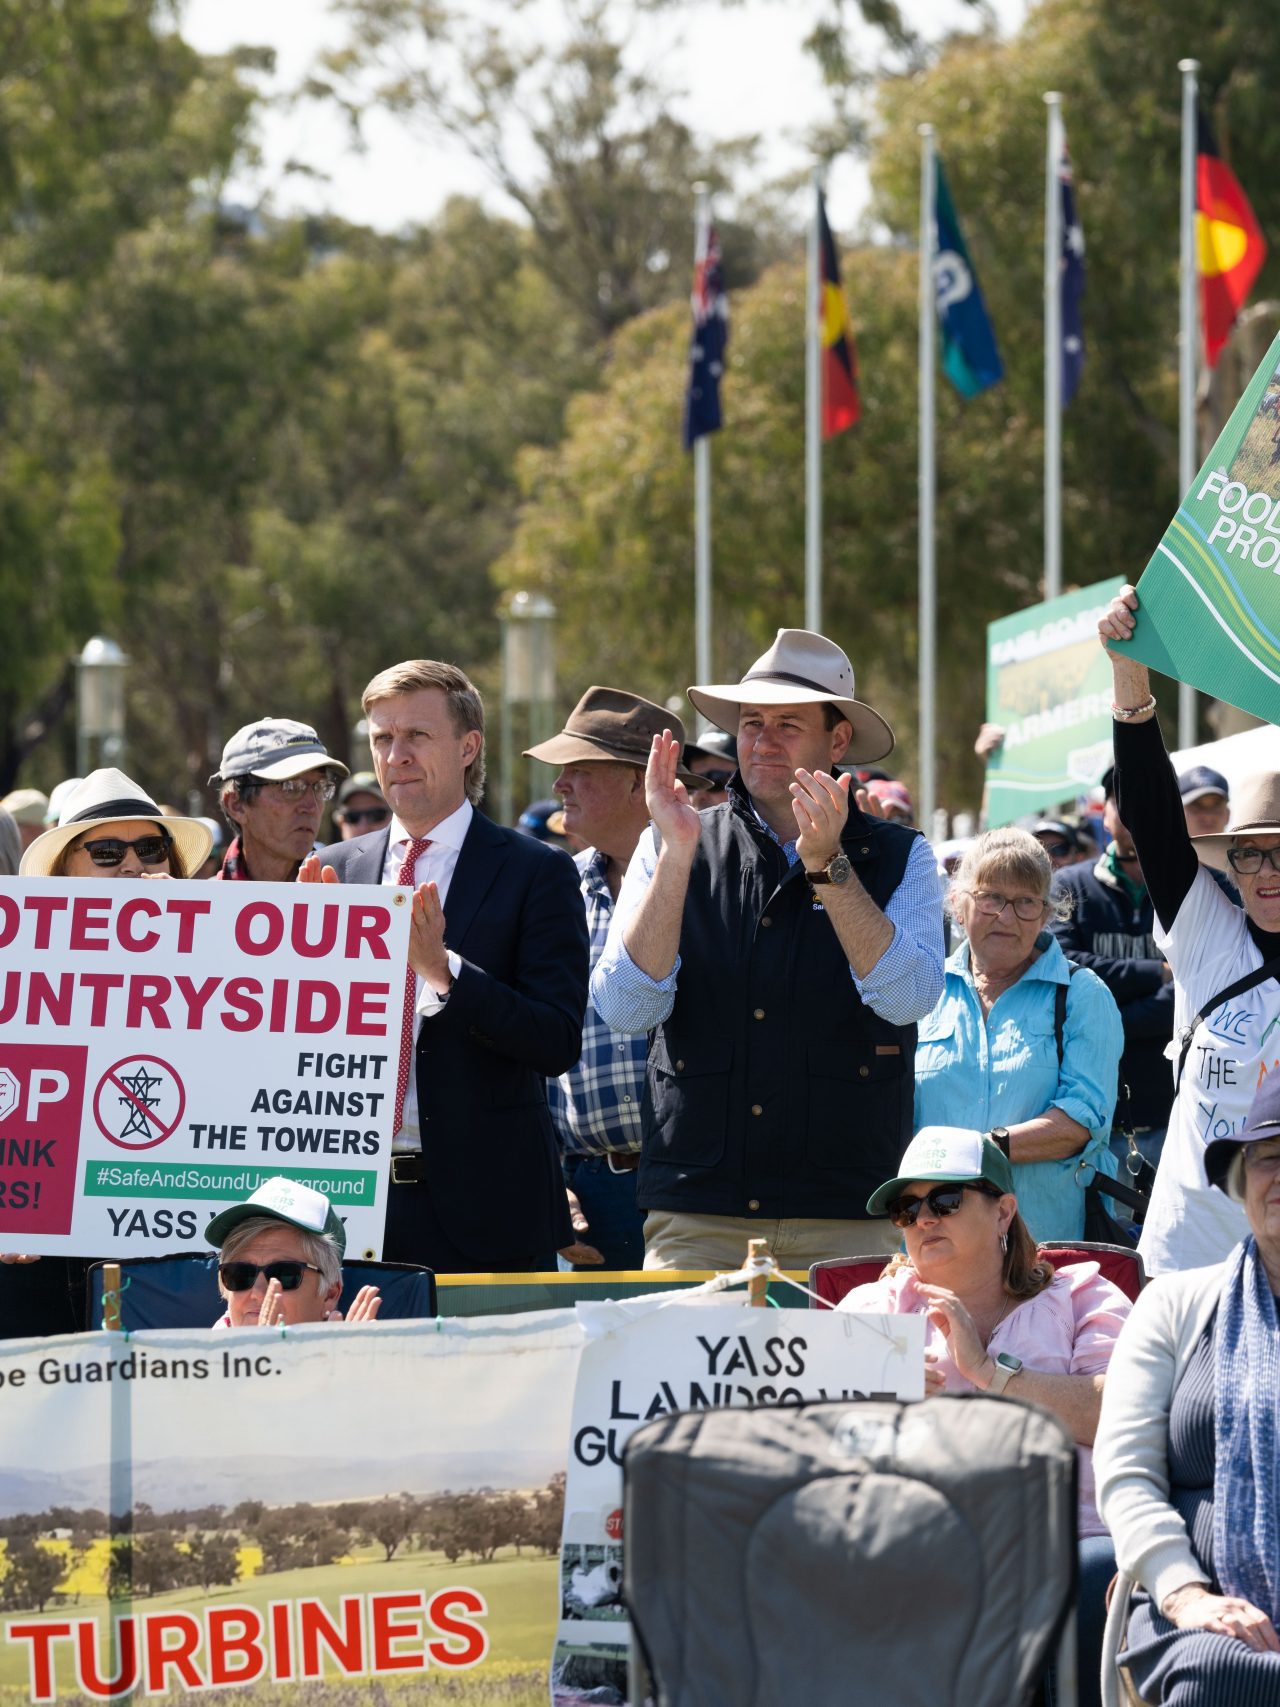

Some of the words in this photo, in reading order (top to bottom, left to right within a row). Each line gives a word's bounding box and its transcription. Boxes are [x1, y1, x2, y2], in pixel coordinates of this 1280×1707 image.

[1003, 688, 1114, 752] ARMERS
[234, 901, 391, 960] OUR
[1213, 1001, 1258, 1036] WE
[297, 1052, 388, 1080] FIGHT
[1197, 1046, 1237, 1089] THE
[250, 1088, 385, 1118] AGAINST
[189, 1124, 248, 1150] THE
[259, 1126, 380, 1156] TOWERS
[97, 1166, 365, 1197] #SafeAndSoundUnground
[107, 1208, 197, 1239] YASS
[38, 1352, 210, 1385] Guardians
[222, 1351, 283, 1379] Inc.
[696, 1336, 808, 1377] YASS
[6, 1586, 489, 1702] TURBINES
